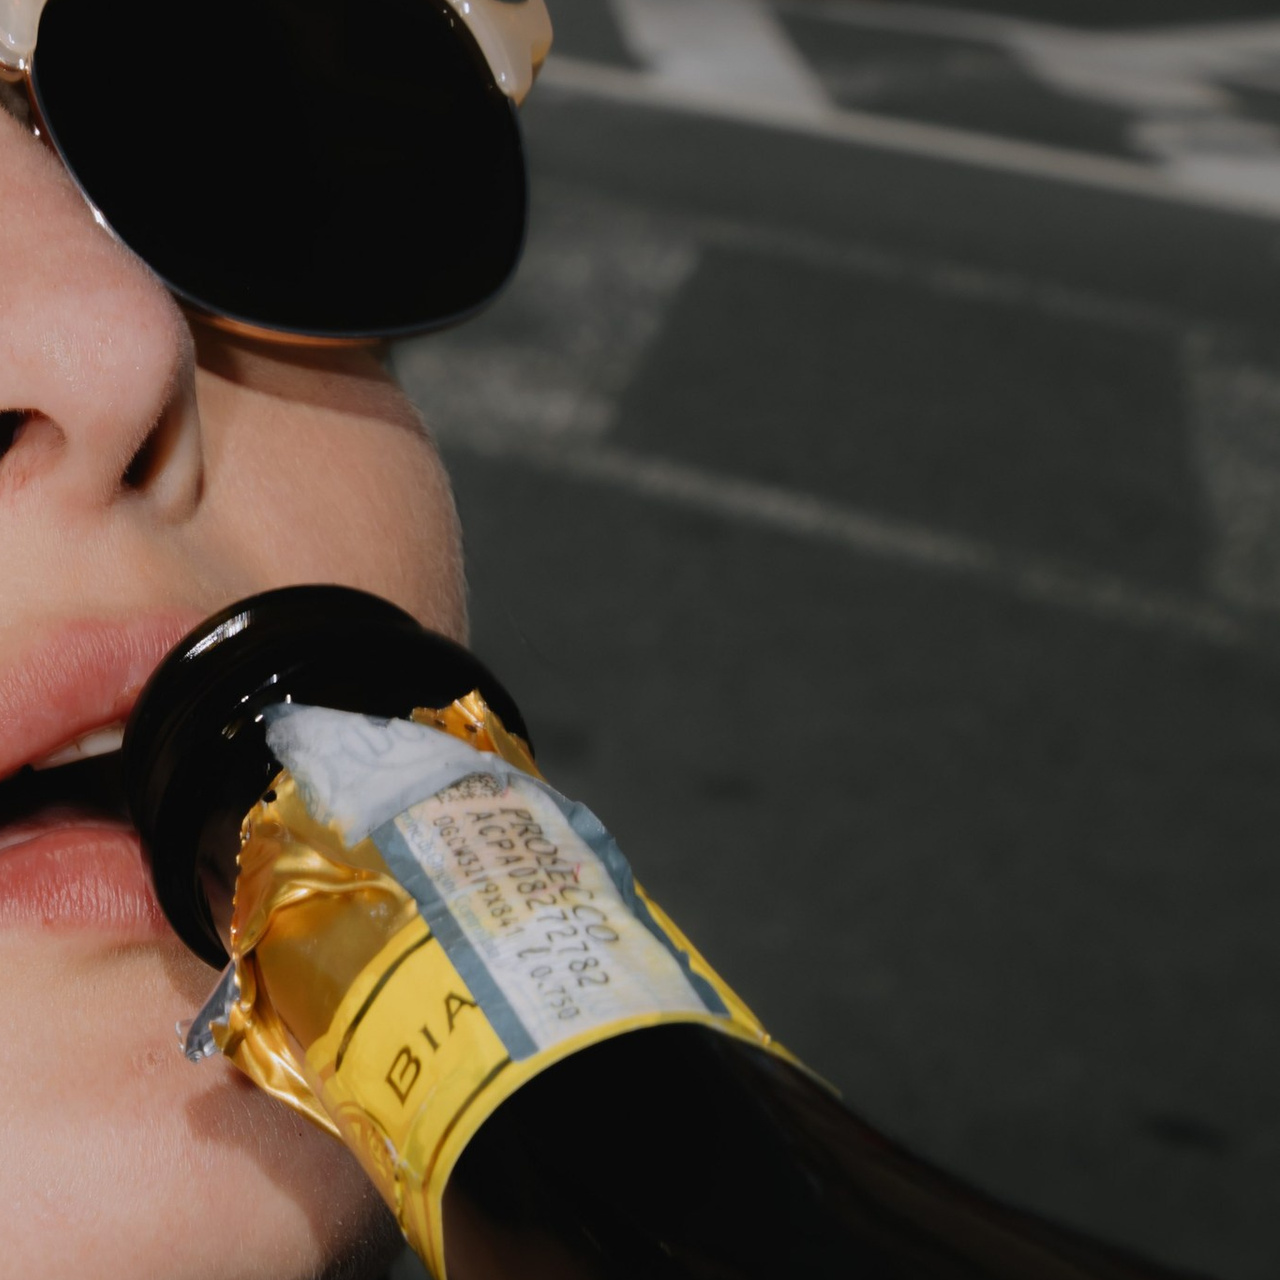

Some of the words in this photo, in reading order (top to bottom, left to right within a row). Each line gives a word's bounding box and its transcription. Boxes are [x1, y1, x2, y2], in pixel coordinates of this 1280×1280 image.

[466, 811, 610, 988] ACPA08272782
[498, 807, 619, 943] PROSECCO
[384, 990, 479, 1106] BIA
[530, 965, 581, 1020] 0.750
